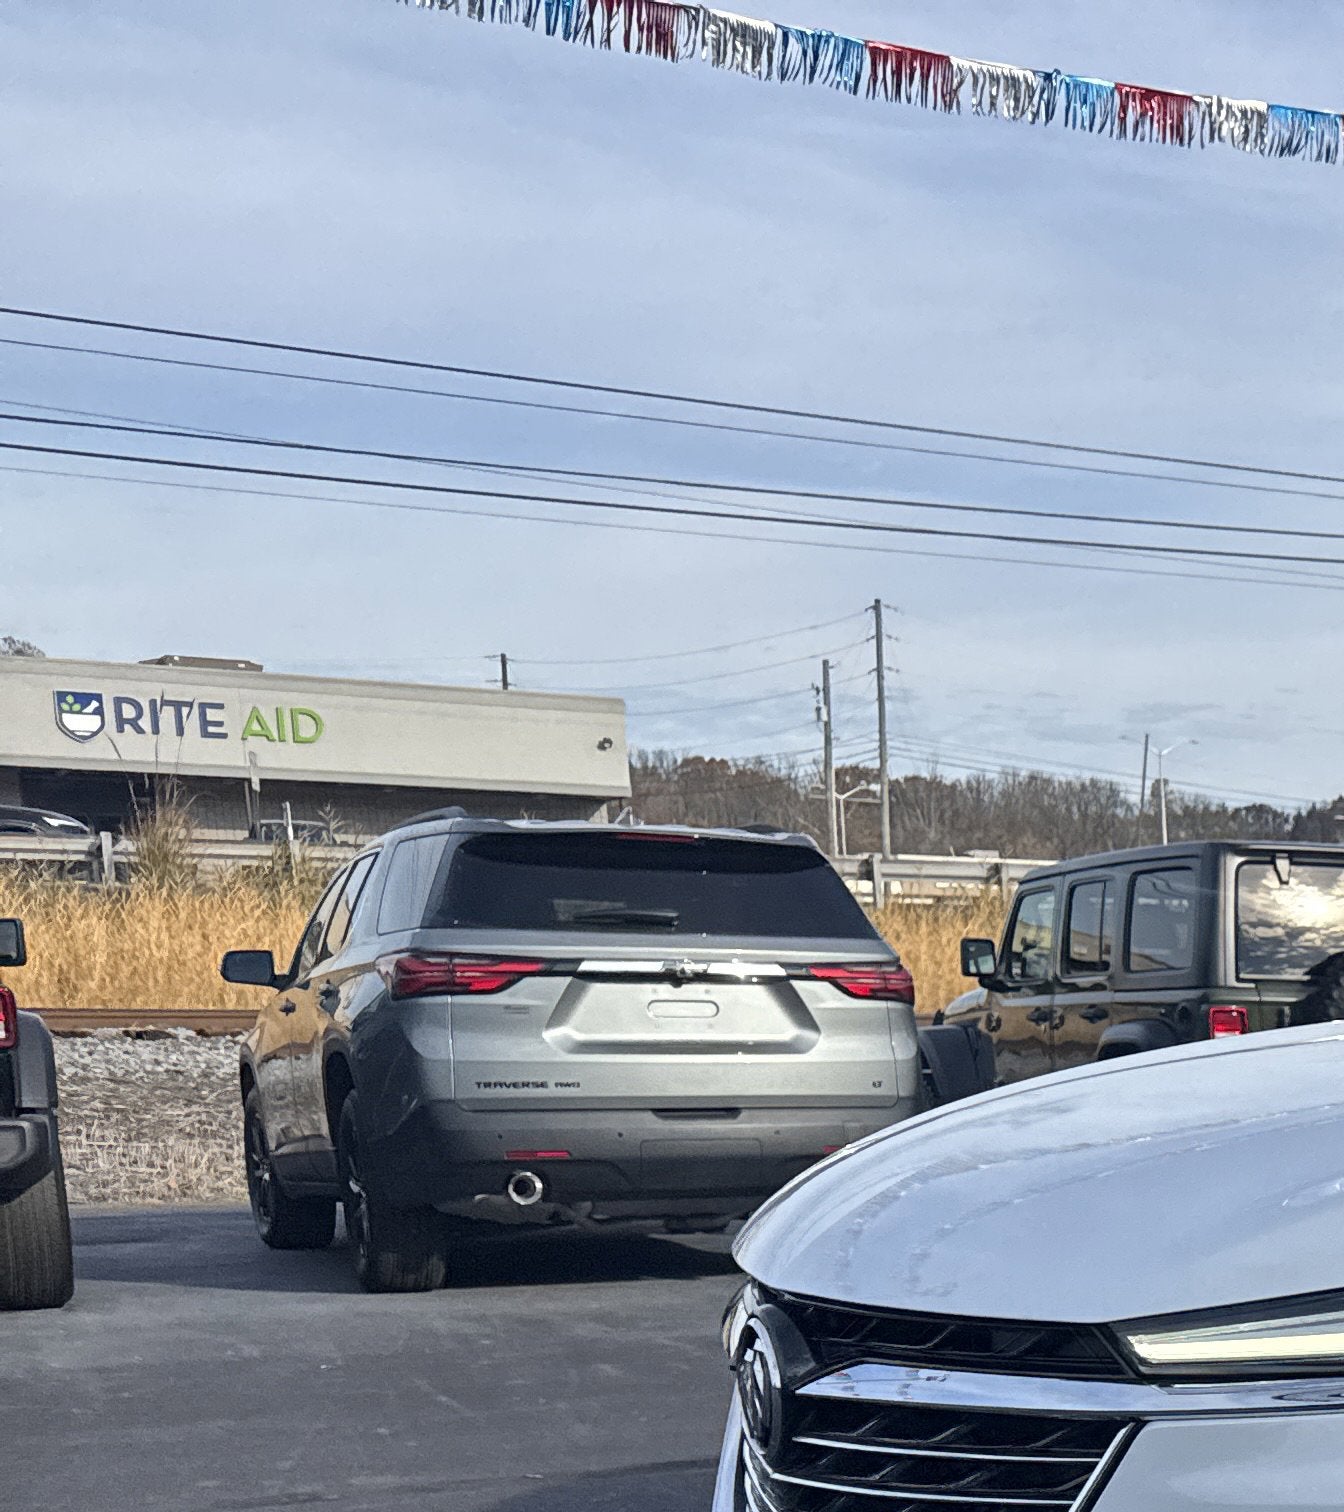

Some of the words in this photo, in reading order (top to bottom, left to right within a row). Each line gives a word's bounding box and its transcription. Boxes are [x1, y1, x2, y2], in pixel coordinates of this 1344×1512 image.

[113, 695, 229, 739] RITE
[240, 705, 325, 744] AID
[475, 1080, 549, 1089] TRAVERSE
